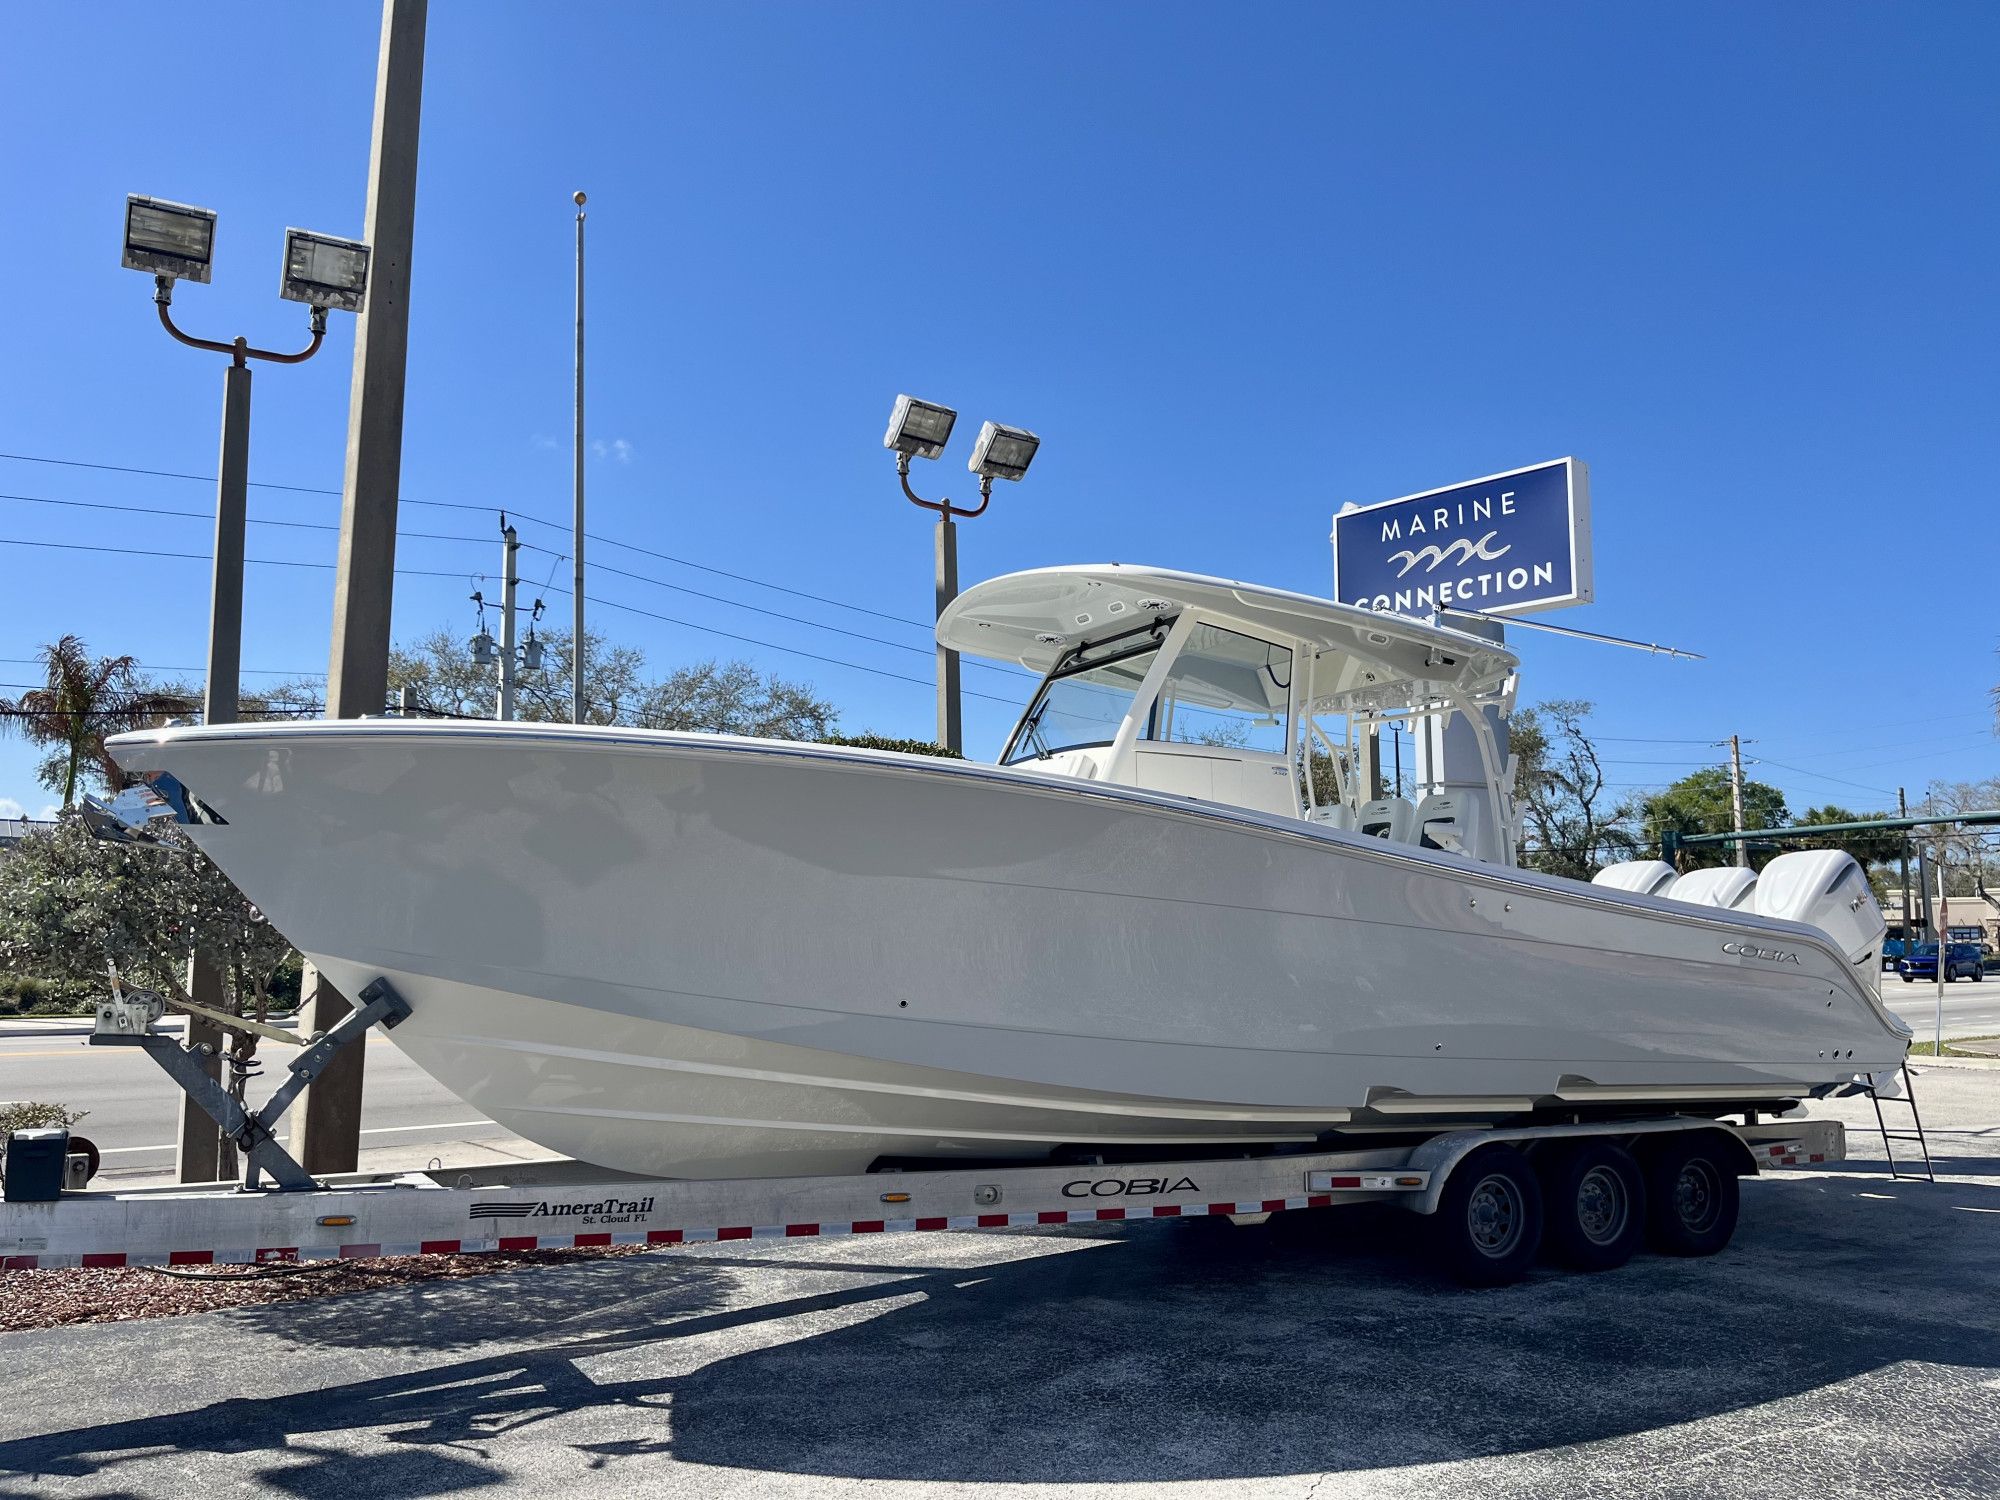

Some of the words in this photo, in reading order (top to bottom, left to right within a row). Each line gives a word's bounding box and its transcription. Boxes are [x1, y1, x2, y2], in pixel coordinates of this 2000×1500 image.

[1381, 491, 1516, 542] MARINE
[1722, 942, 1800, 965] COBIA
[1061, 1176, 1201, 1198] COBIA
[532, 1197, 655, 1217] AmeraTrail
[582, 1215, 597, 1225] St.
[600, 1214, 630, 1223] Cloud
[634, 1214, 648, 1222] FL
